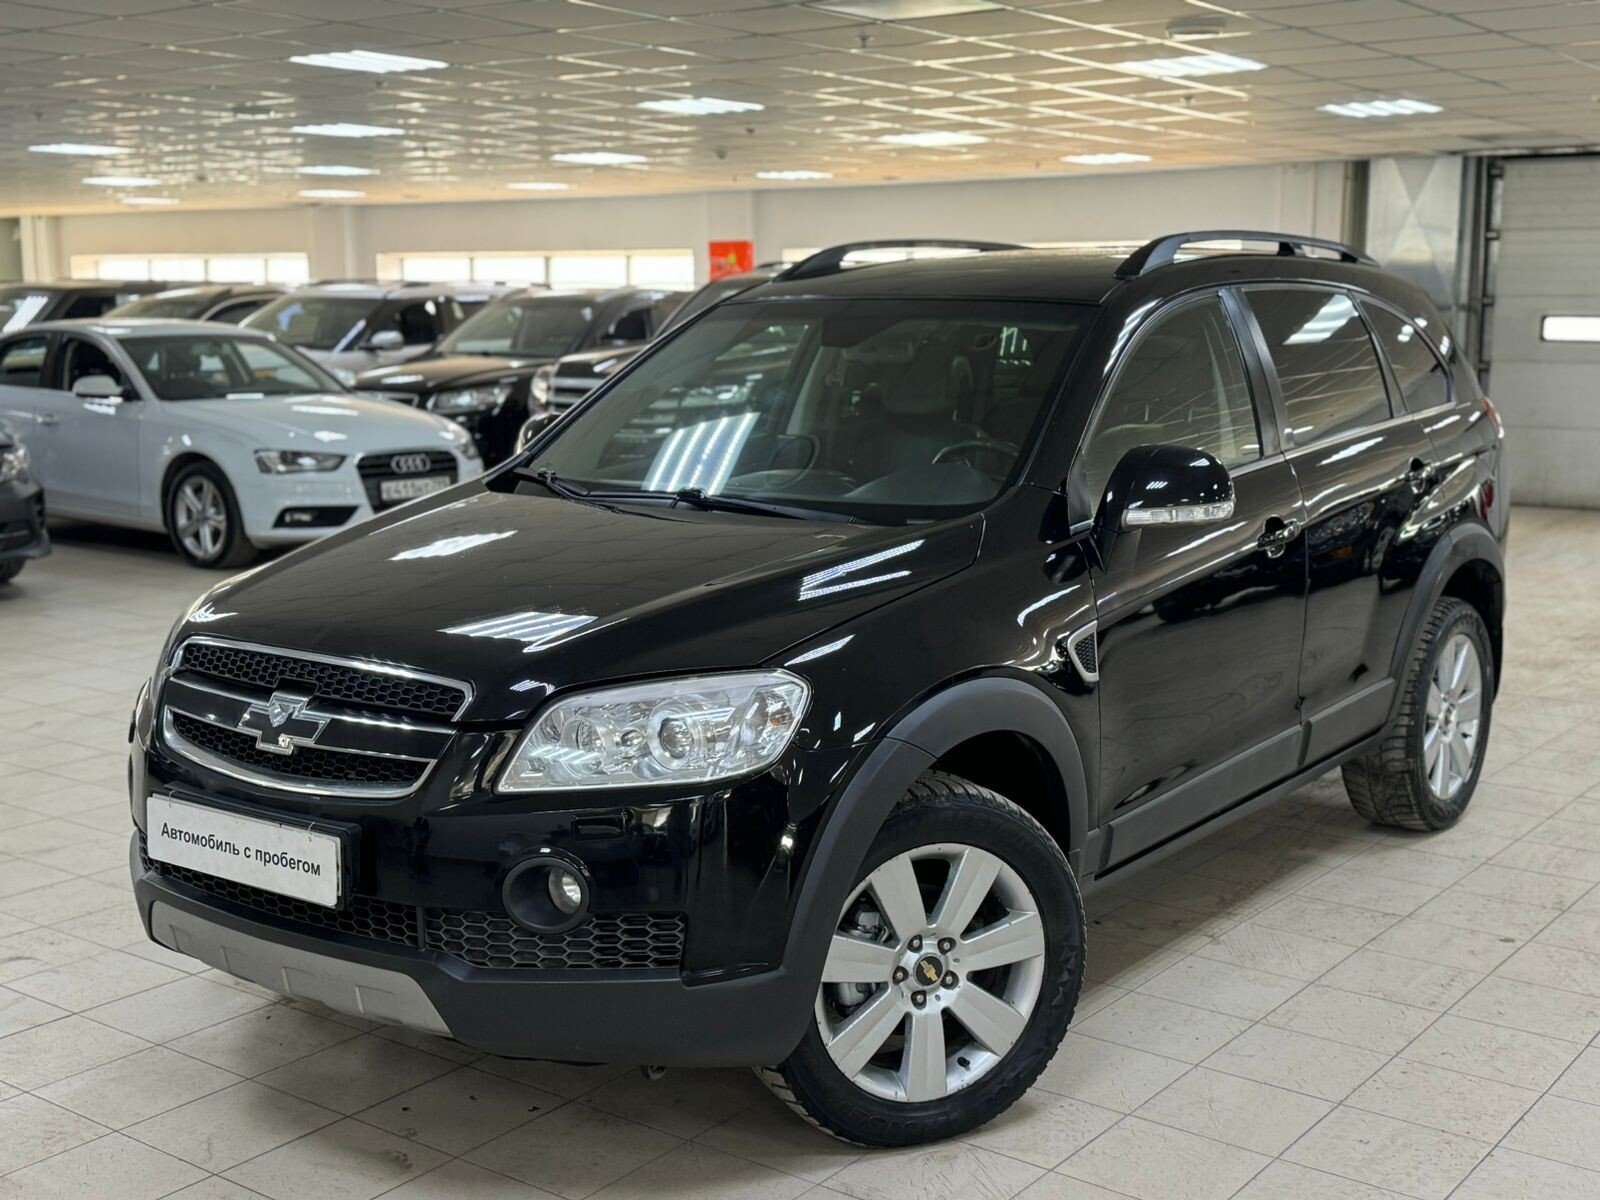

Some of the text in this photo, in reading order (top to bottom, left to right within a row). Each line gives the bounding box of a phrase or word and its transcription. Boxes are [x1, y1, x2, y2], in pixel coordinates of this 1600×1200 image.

[161, 822, 321, 877] Автомобиль с пробегом
